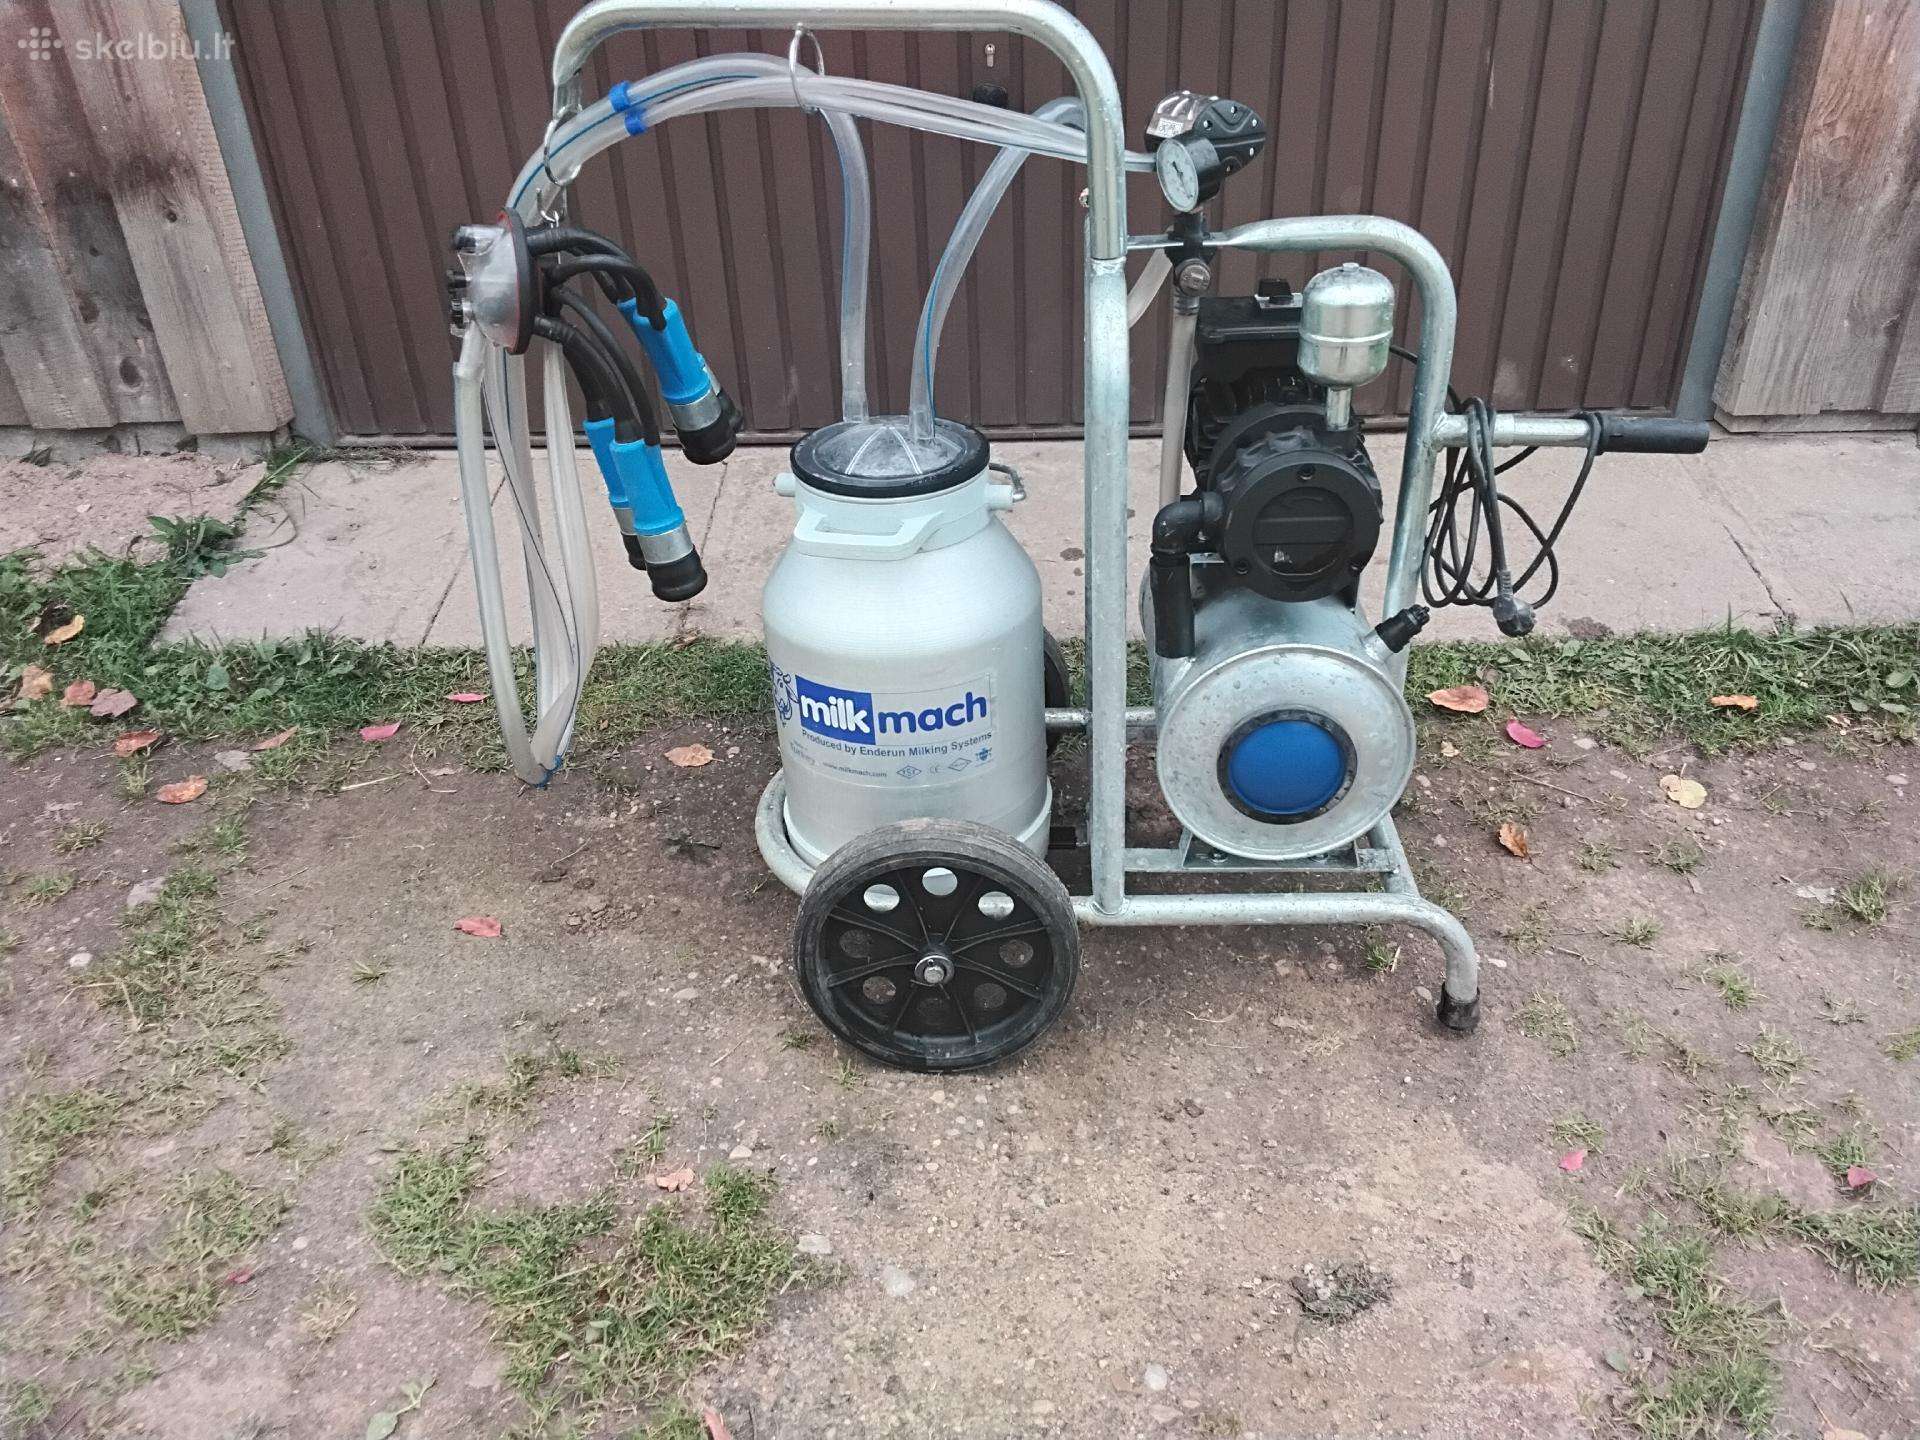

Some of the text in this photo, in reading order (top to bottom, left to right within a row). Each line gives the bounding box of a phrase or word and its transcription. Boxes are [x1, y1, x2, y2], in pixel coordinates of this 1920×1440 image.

[800, 691, 987, 734] milk mach
[802, 729, 842, 752] Produced
[844, 742, 857, 756] by
[860, 746, 906, 757] Enderun
[908, 744, 948, 757] Milking
[951, 731, 992, 751] Systems
